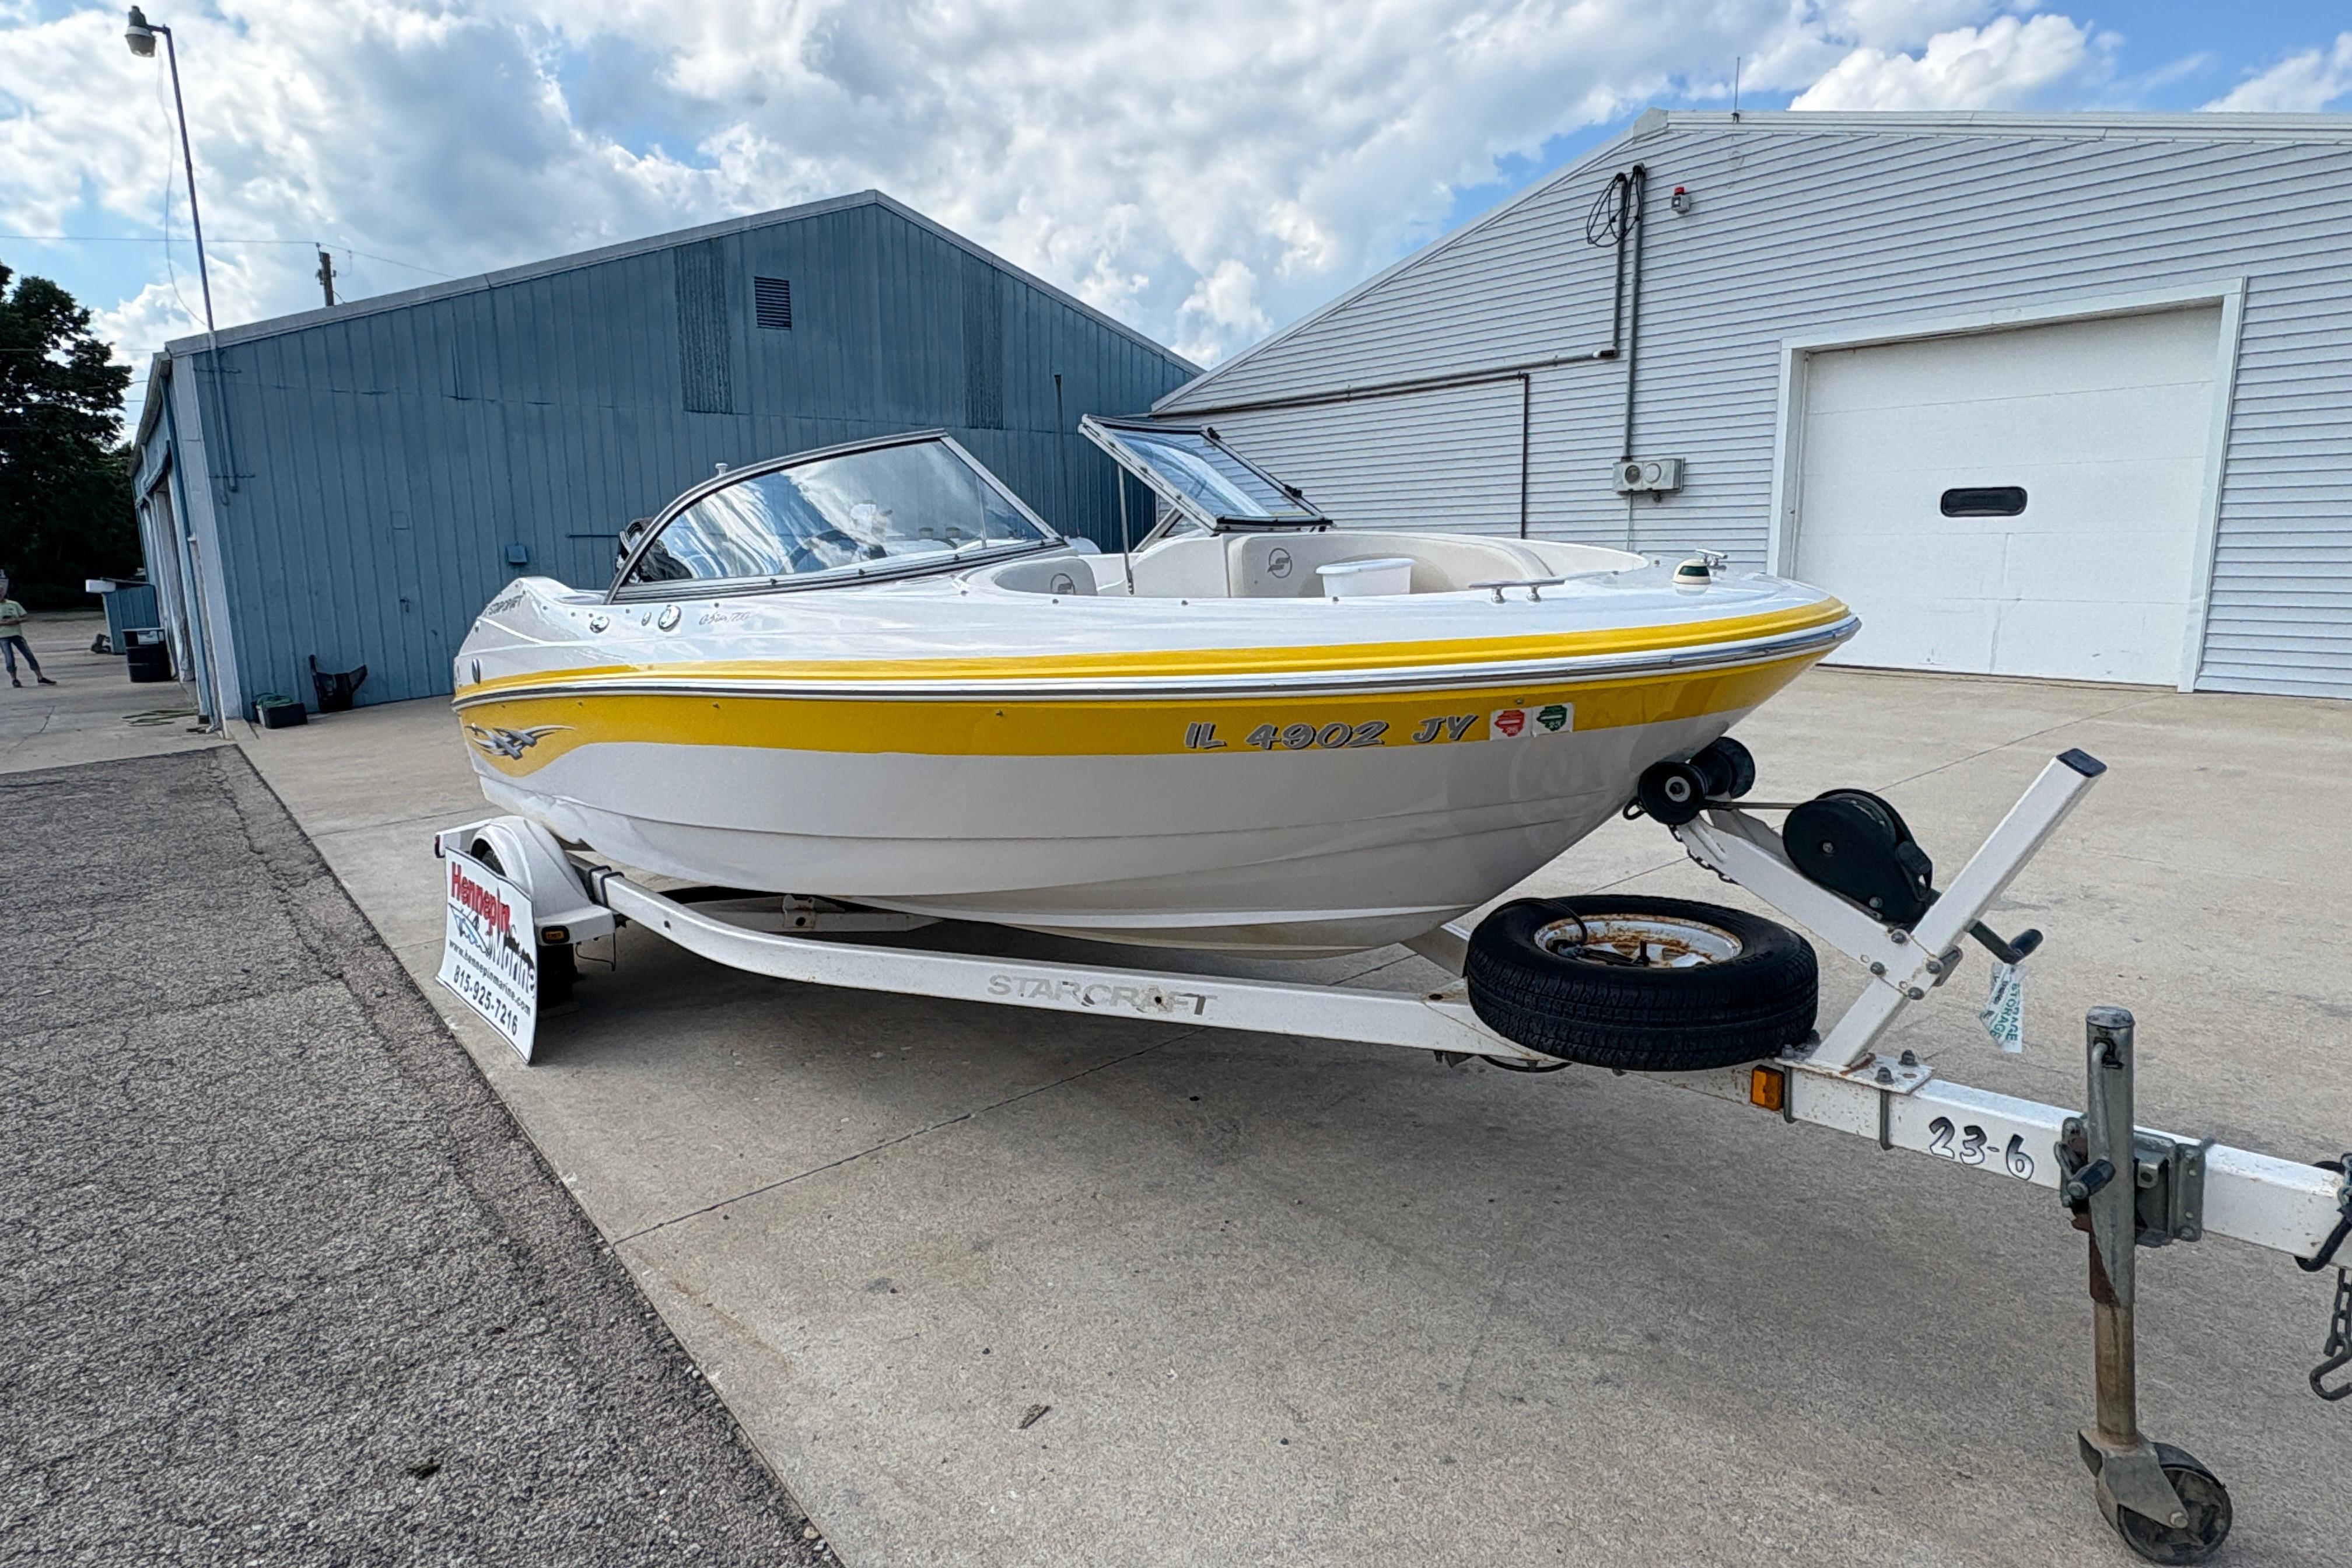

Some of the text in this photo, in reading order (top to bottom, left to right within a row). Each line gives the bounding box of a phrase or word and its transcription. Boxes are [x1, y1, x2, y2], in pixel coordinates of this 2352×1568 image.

[1184, 714, 1479, 750] IL 4902 JY
[451, 861, 510, 936] Hennepin
[453, 964, 518, 1036] 815-925-7216
[1929, 1116, 2035, 1181] 23-6
